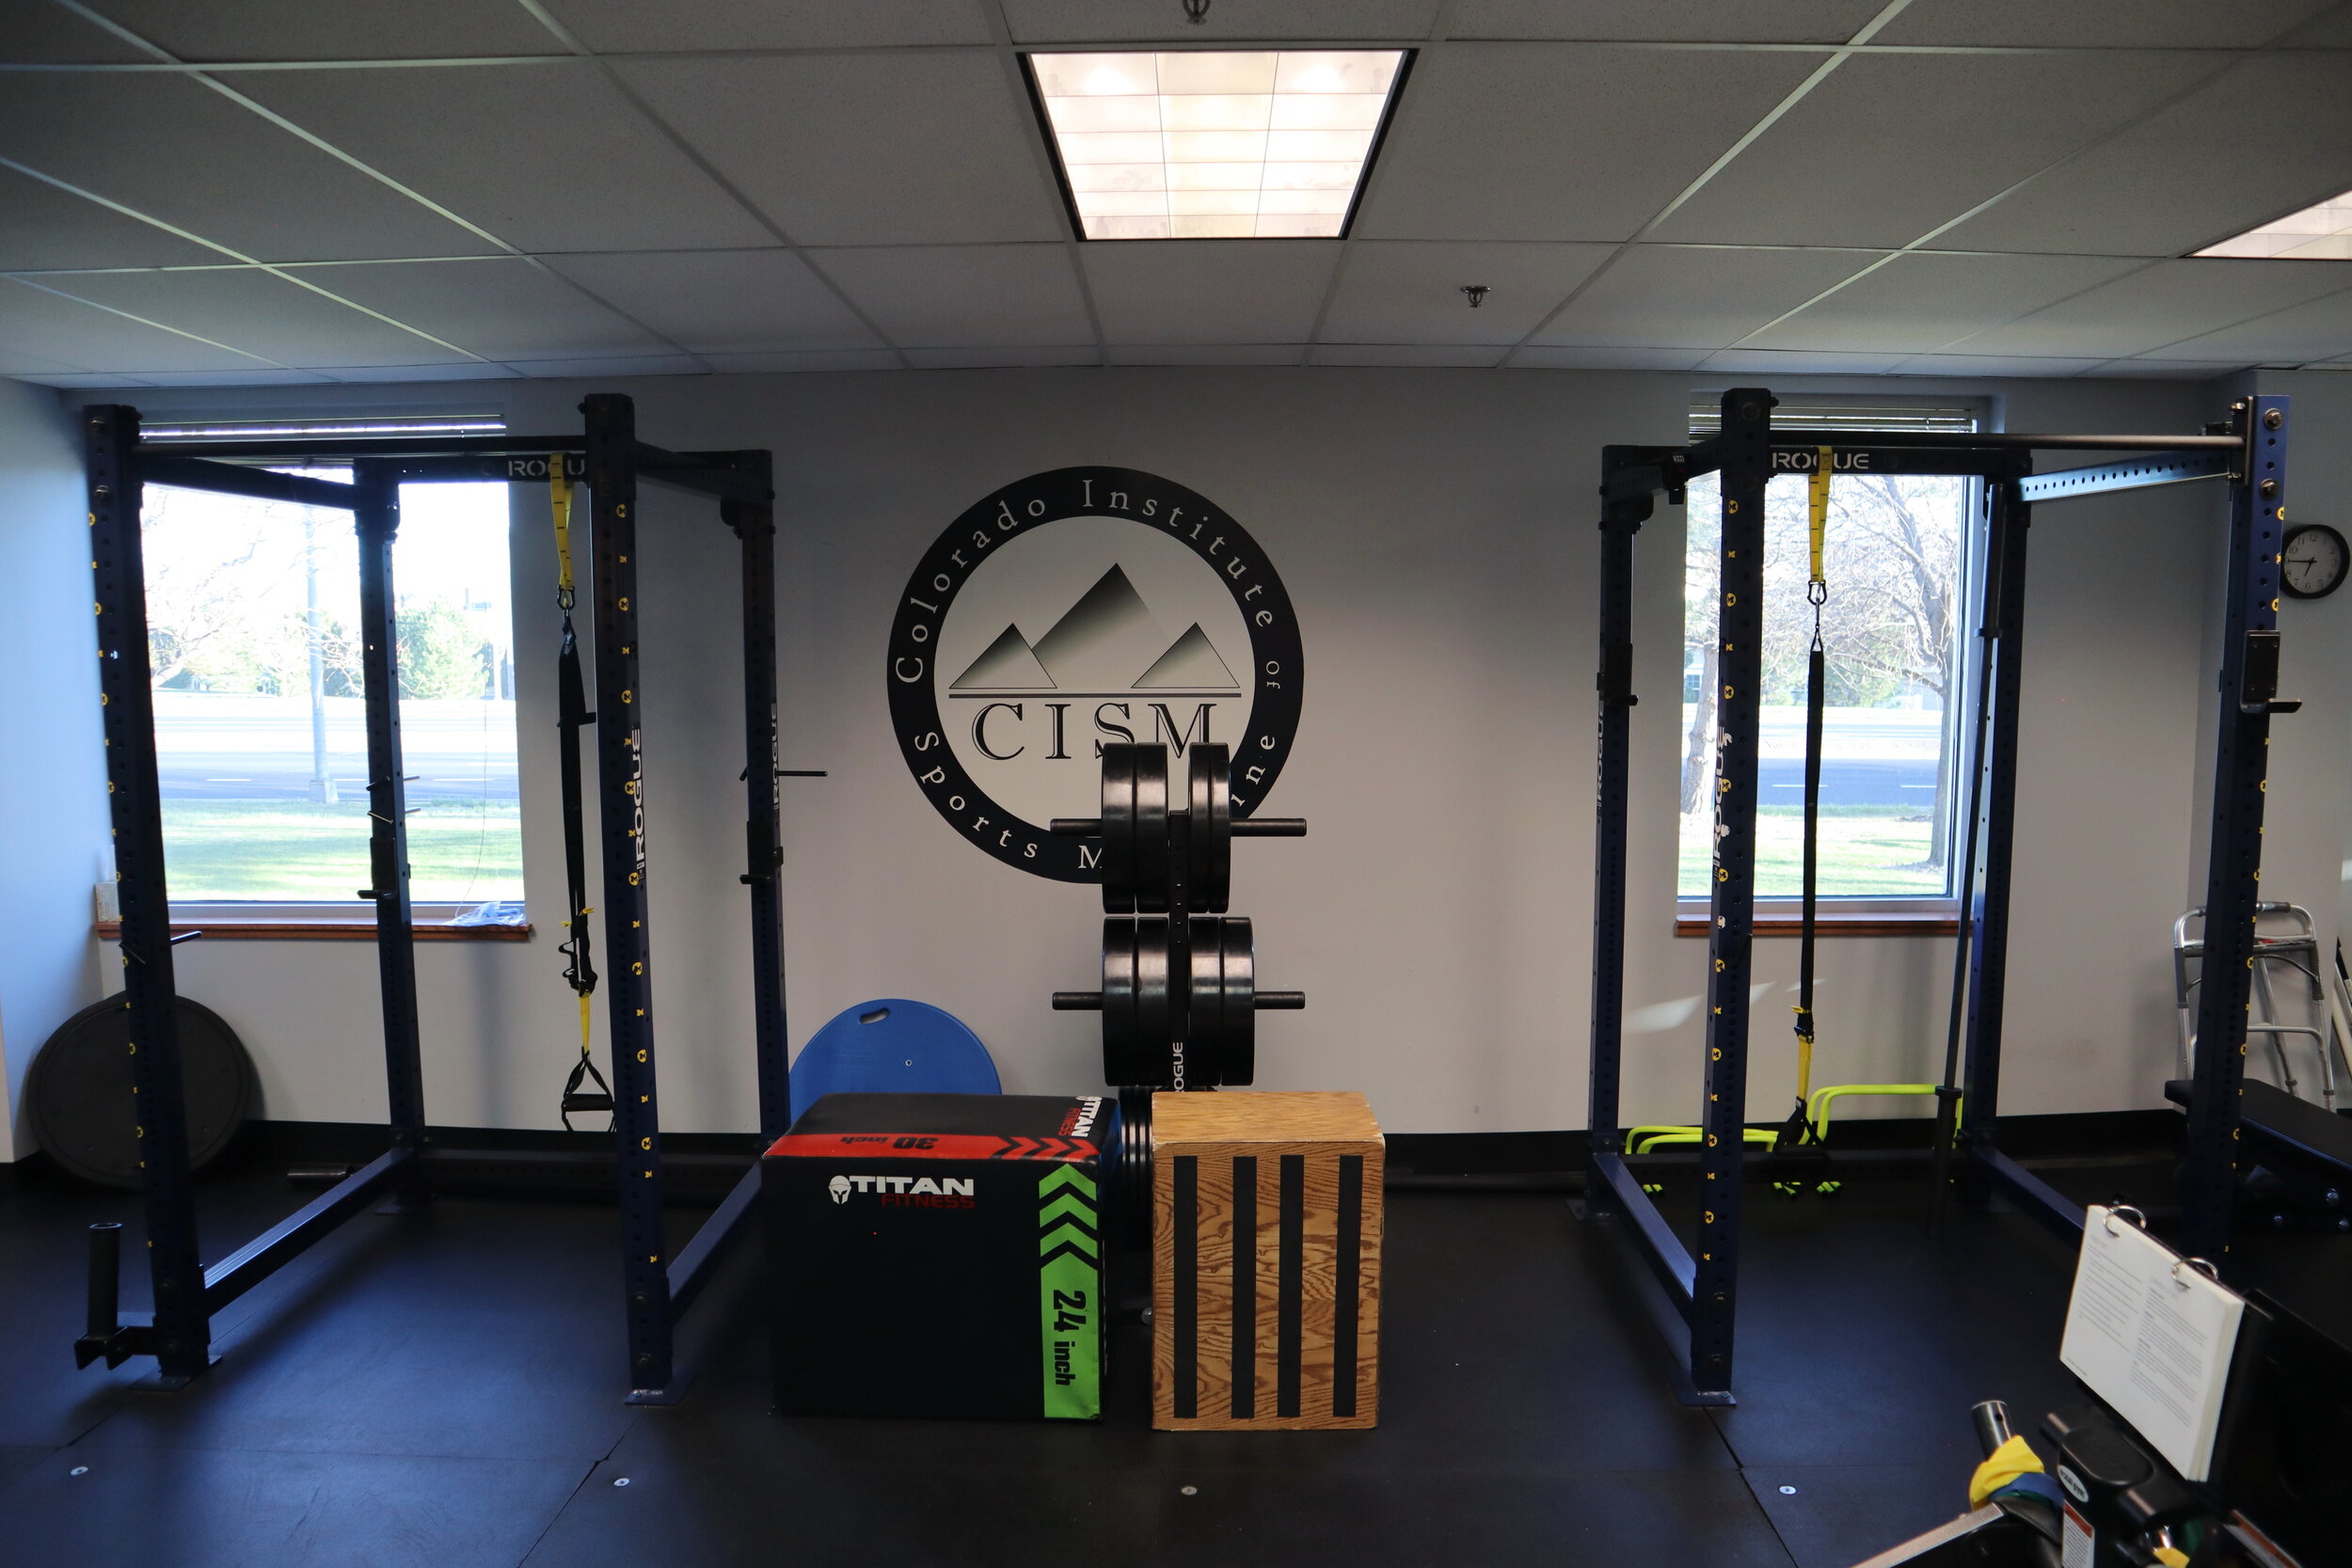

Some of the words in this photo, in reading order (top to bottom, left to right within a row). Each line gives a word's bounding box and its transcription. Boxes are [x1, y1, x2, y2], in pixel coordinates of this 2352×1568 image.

[508, 459, 585, 478] ROU
[895, 499, 1047, 685] Colorado
[1081, 478, 1275, 628] Institute
[1264, 659, 1281, 689] of
[970, 702, 1217, 761] CISM
[631, 727, 645, 863] ROGUE
[913, 730, 1039, 860] Sports
[1172, 1041, 1184, 1092] OGUE
[839, 1136, 888, 1145] inch
[893, 1136, 939, 1149] 30
[849, 1175, 975, 1196] TITAN
[880, 1193, 977, 1210] FITNESS
[1053, 1289, 1087, 1332] 24
[1054, 1340, 1076, 1386] inch
